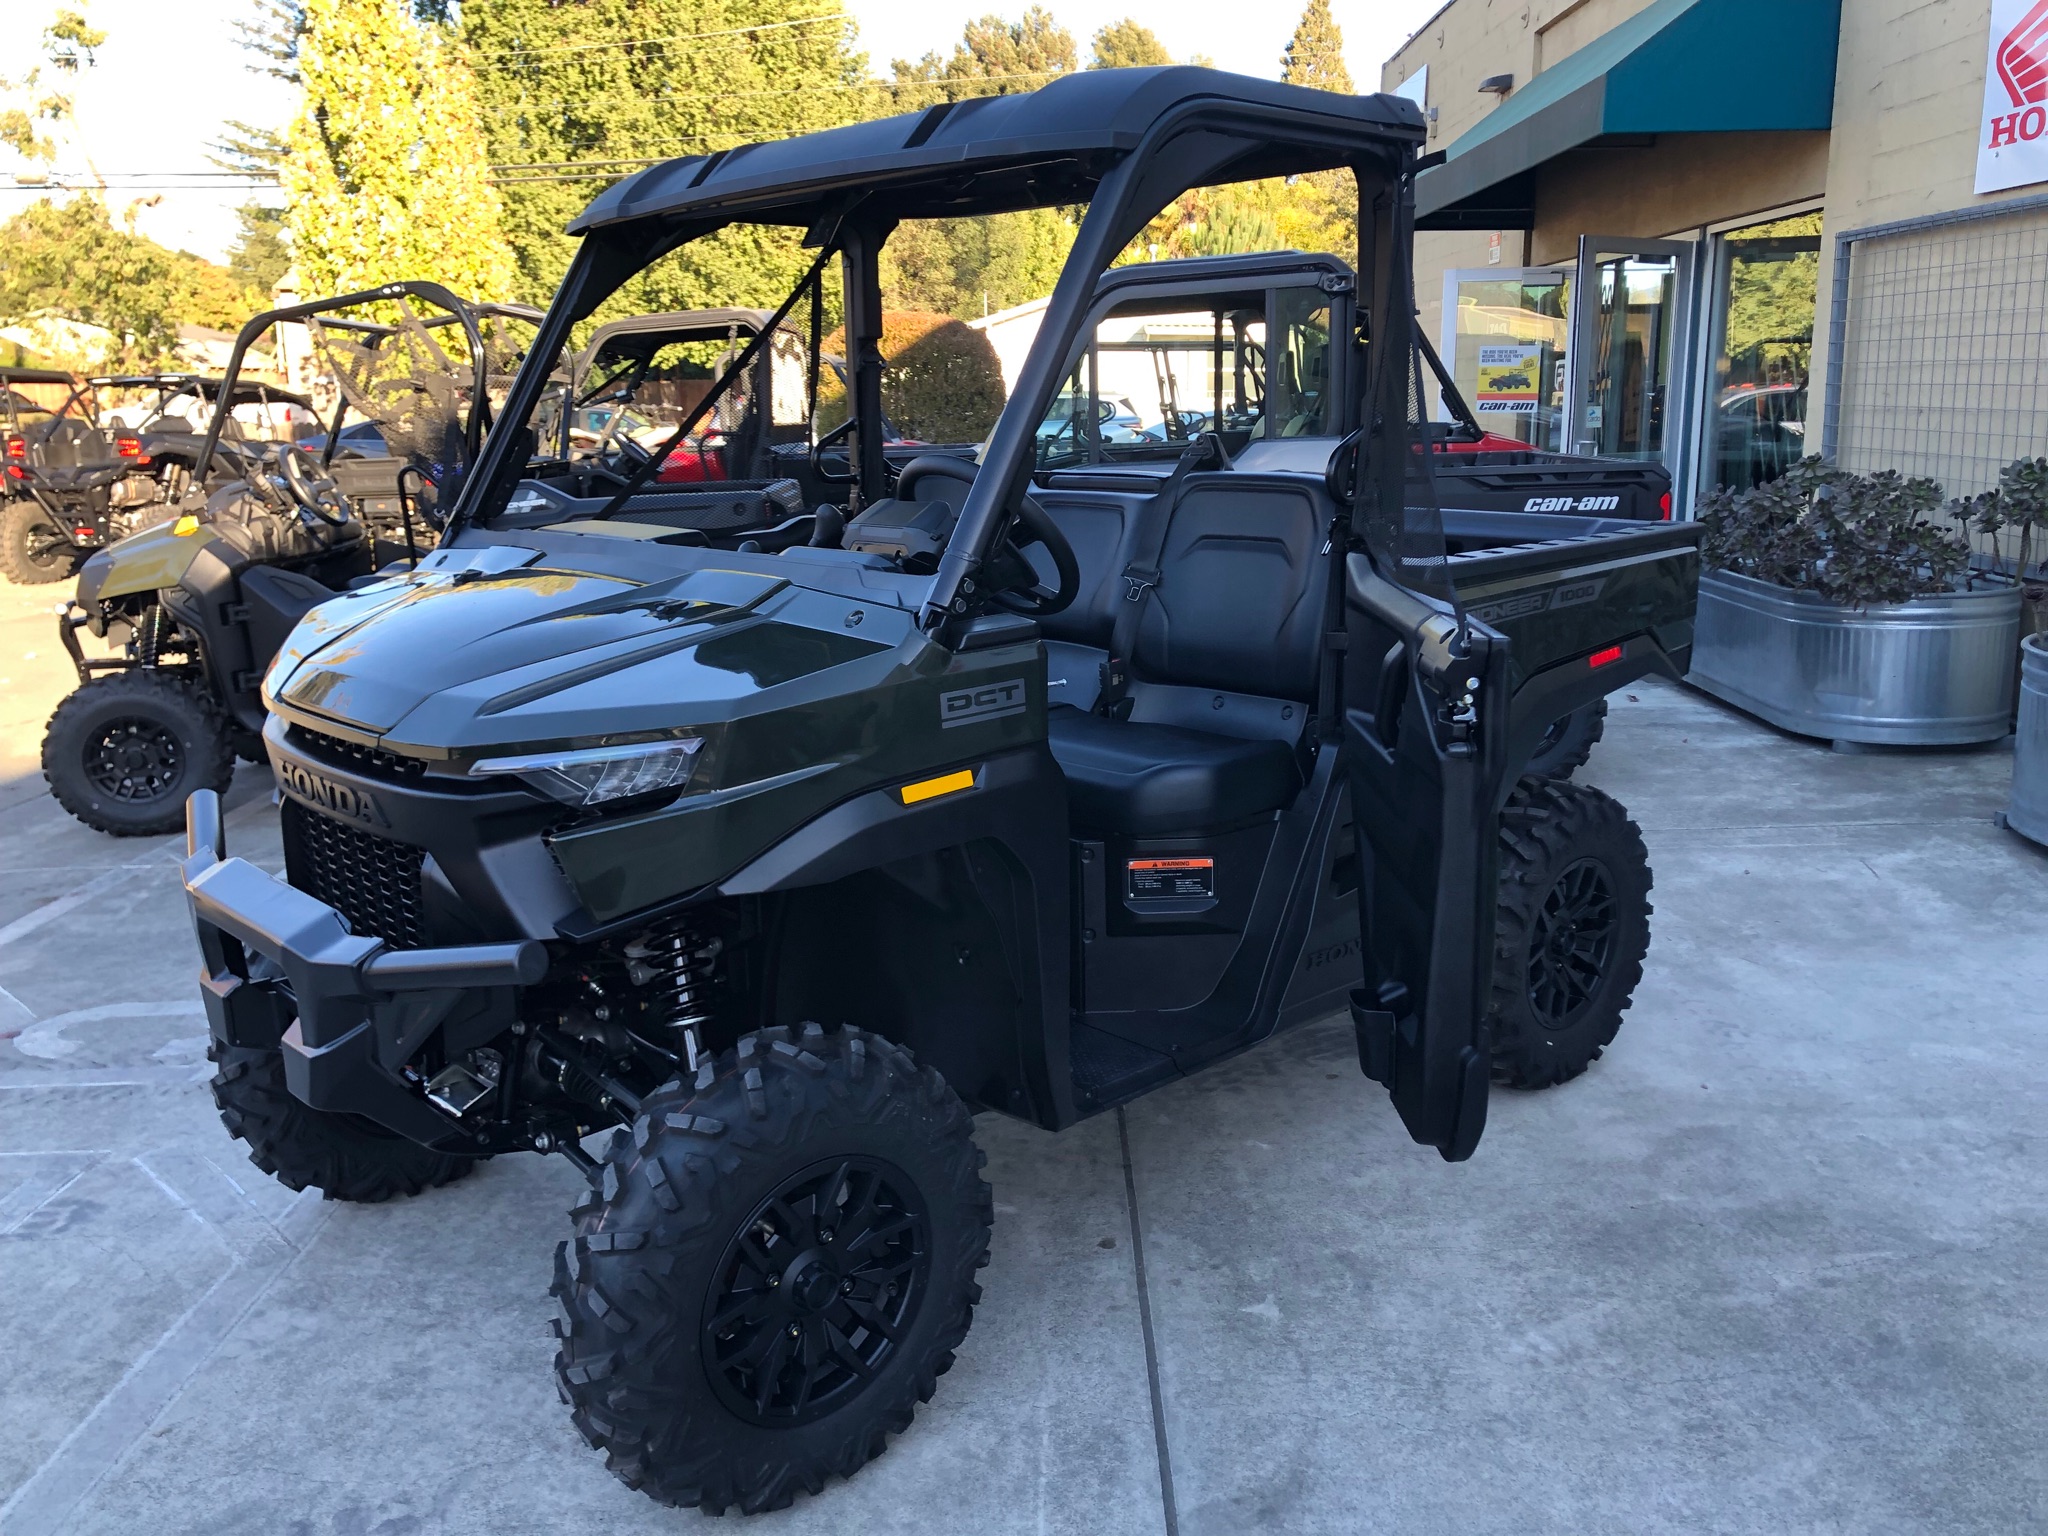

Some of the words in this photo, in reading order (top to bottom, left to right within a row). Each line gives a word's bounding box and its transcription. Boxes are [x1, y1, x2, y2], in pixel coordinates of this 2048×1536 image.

[1988, 106, 2048, 149] HO
[1479, 402, 1535, 411] can-am
[1523, 495, 1620, 512] can-am
[1560, 585, 1595, 603] 1000
[946, 684, 1020, 713] DCT
[280, 759, 391, 829] HONDA
